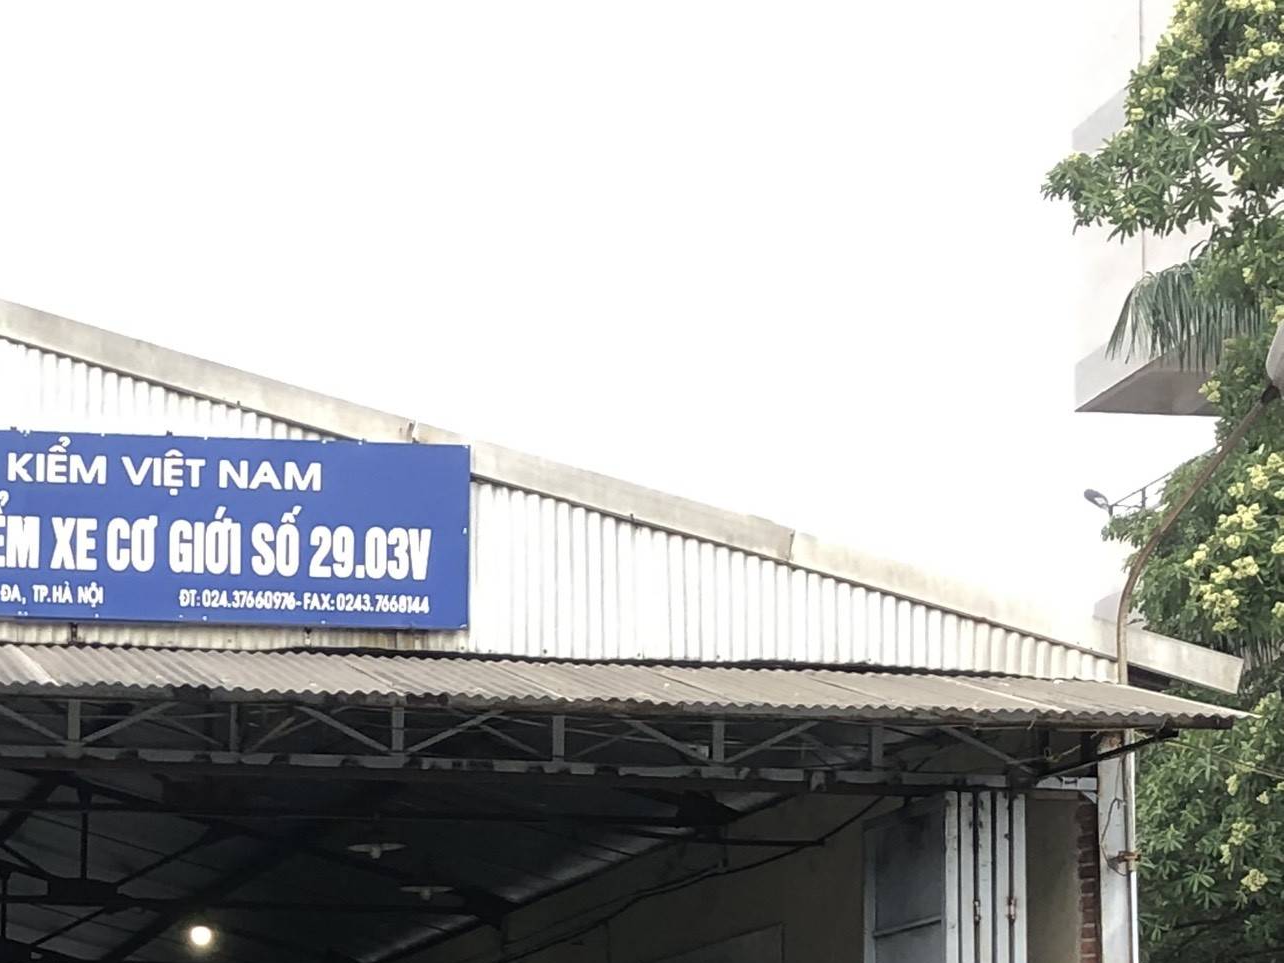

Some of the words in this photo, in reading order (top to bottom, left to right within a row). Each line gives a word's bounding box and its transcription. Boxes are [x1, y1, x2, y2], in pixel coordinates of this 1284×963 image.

[6, 436, 108, 486] KIỂM
[121, 449, 206, 496] VIỆT
[218, 459, 322, 492] NAM
[50, 517, 98, 572] XE
[106, 514, 159, 573] CƠ
[168, 506, 242, 576] GIỚI
[251, 505, 303, 578] SỐ
[309, 525, 432, 581] 29.03V
[77, 581, 104, 608] NỘI
